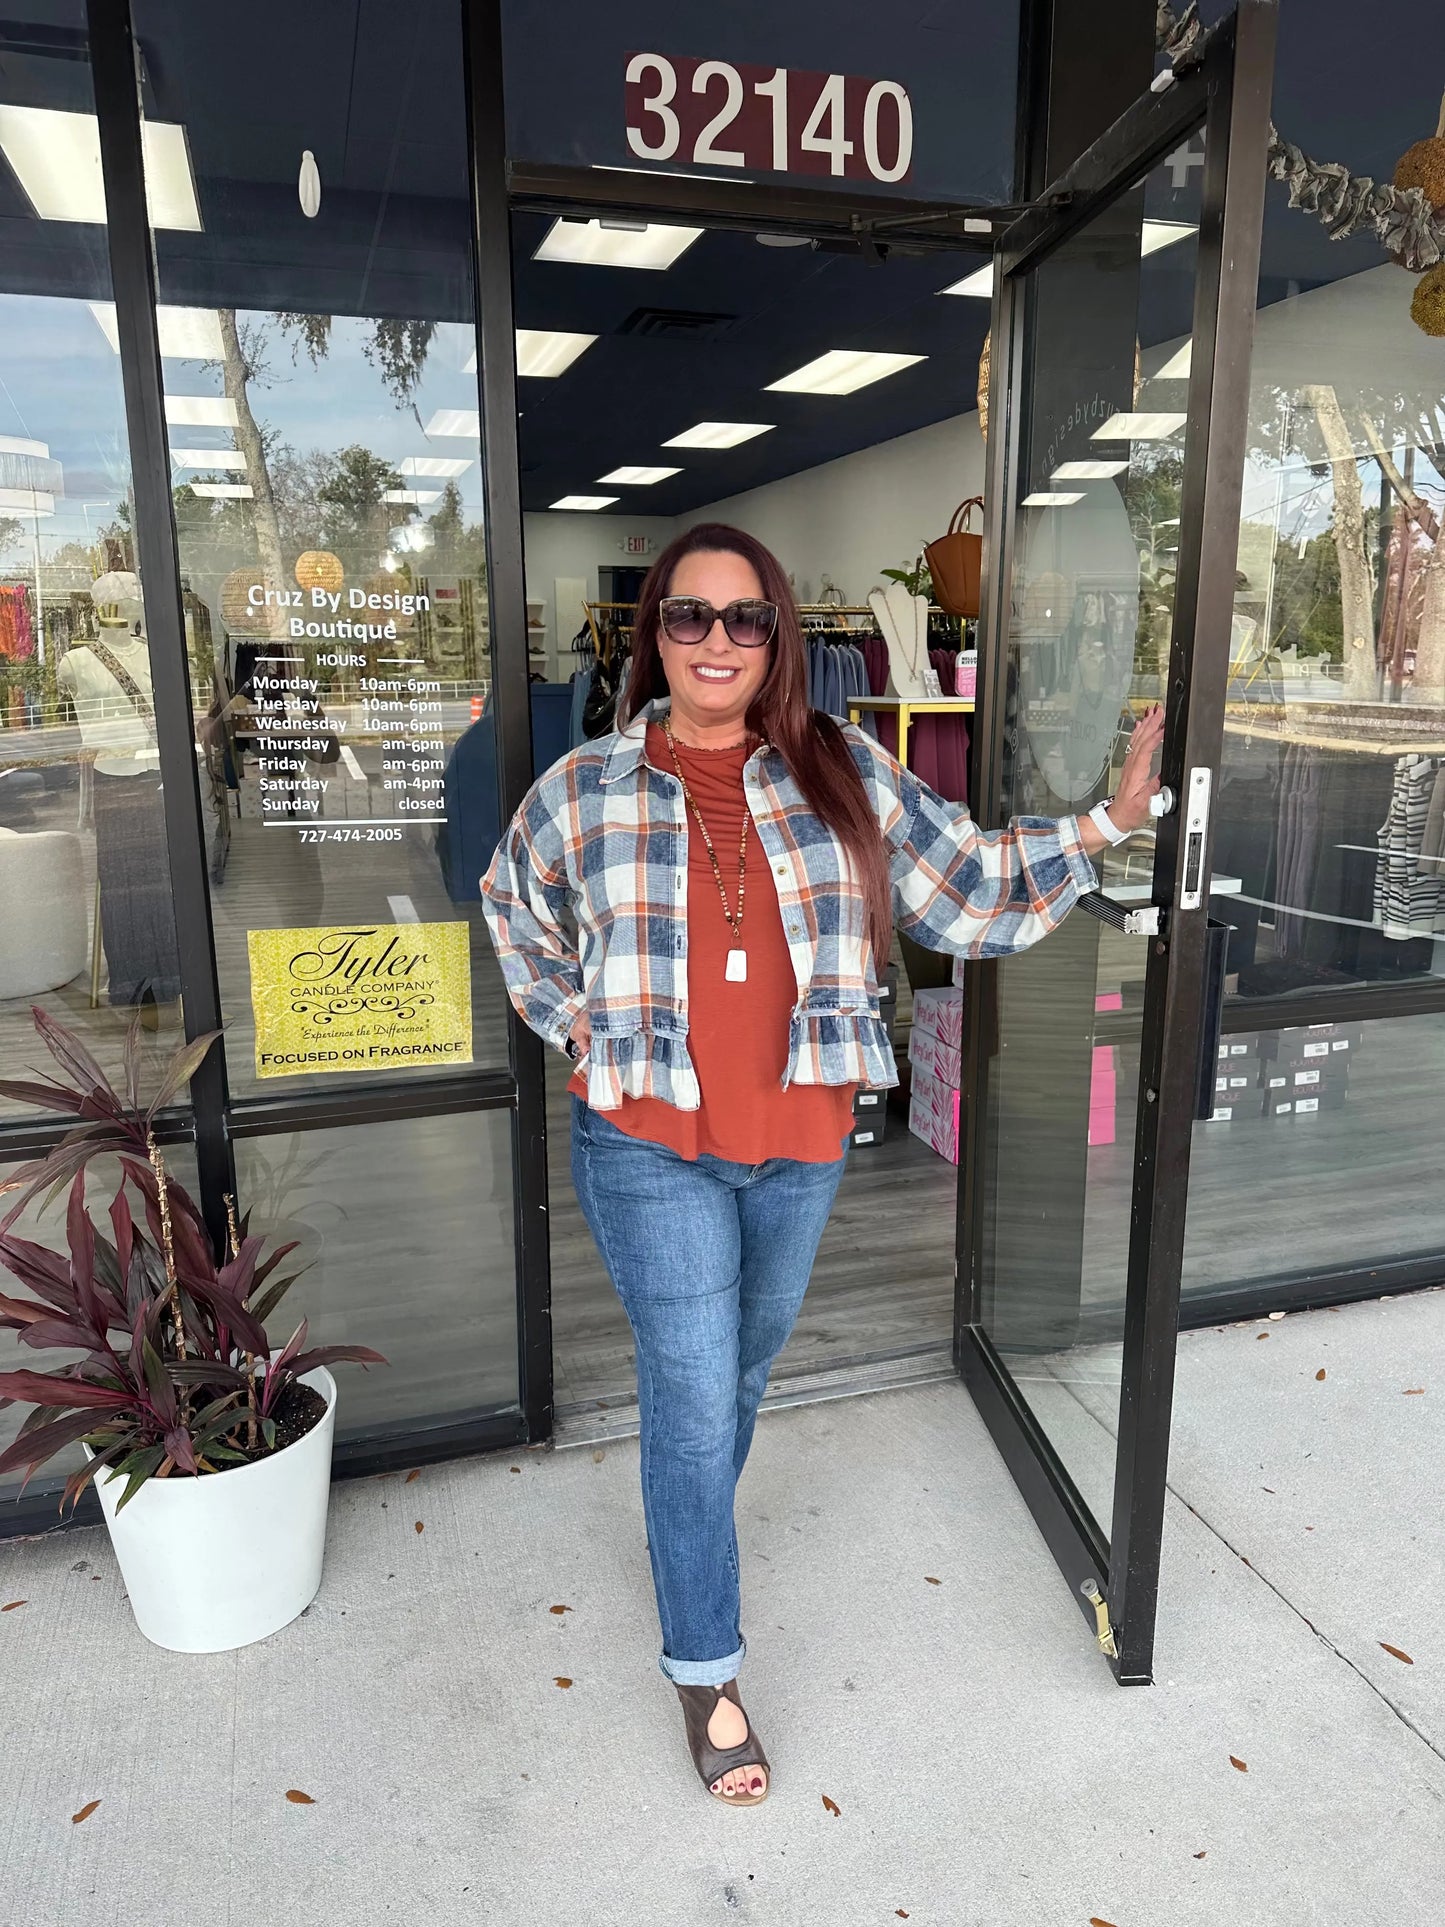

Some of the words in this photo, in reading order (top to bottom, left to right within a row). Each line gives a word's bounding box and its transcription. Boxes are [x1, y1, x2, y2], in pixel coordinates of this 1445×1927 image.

[625, 53, 913, 183] 32140
[628, 537, 645, 552] EXIT
[248, 585, 303, 607] Cruz
[311, 587, 341, 613] By
[349, 588, 430, 615] Design
[290, 617, 397, 643] Boutique
[316, 654, 367, 667] HOURS
[253, 676, 318, 694] Monday
[359, 677, 440, 695] 10am-6pm
[254, 696, 319, 713] Tuesday
[361, 698, 442, 715] 10am-6pm
[255, 717, 347, 733] Wednesday
[362, 718, 443, 735] 10am-6pm
[256, 737, 329, 753] Thursday
[258, 757, 307, 773] Friday
[259, 777, 328, 793] Saturday
[262, 797, 320, 814] Sunday
[398, 797, 445, 810] closed
[298, 828, 403, 843] 727-474-2005
[289, 929, 434, 987] Tyler
[290, 984, 355, 997] CANDLE
[356, 1024, 371, 1036] the
